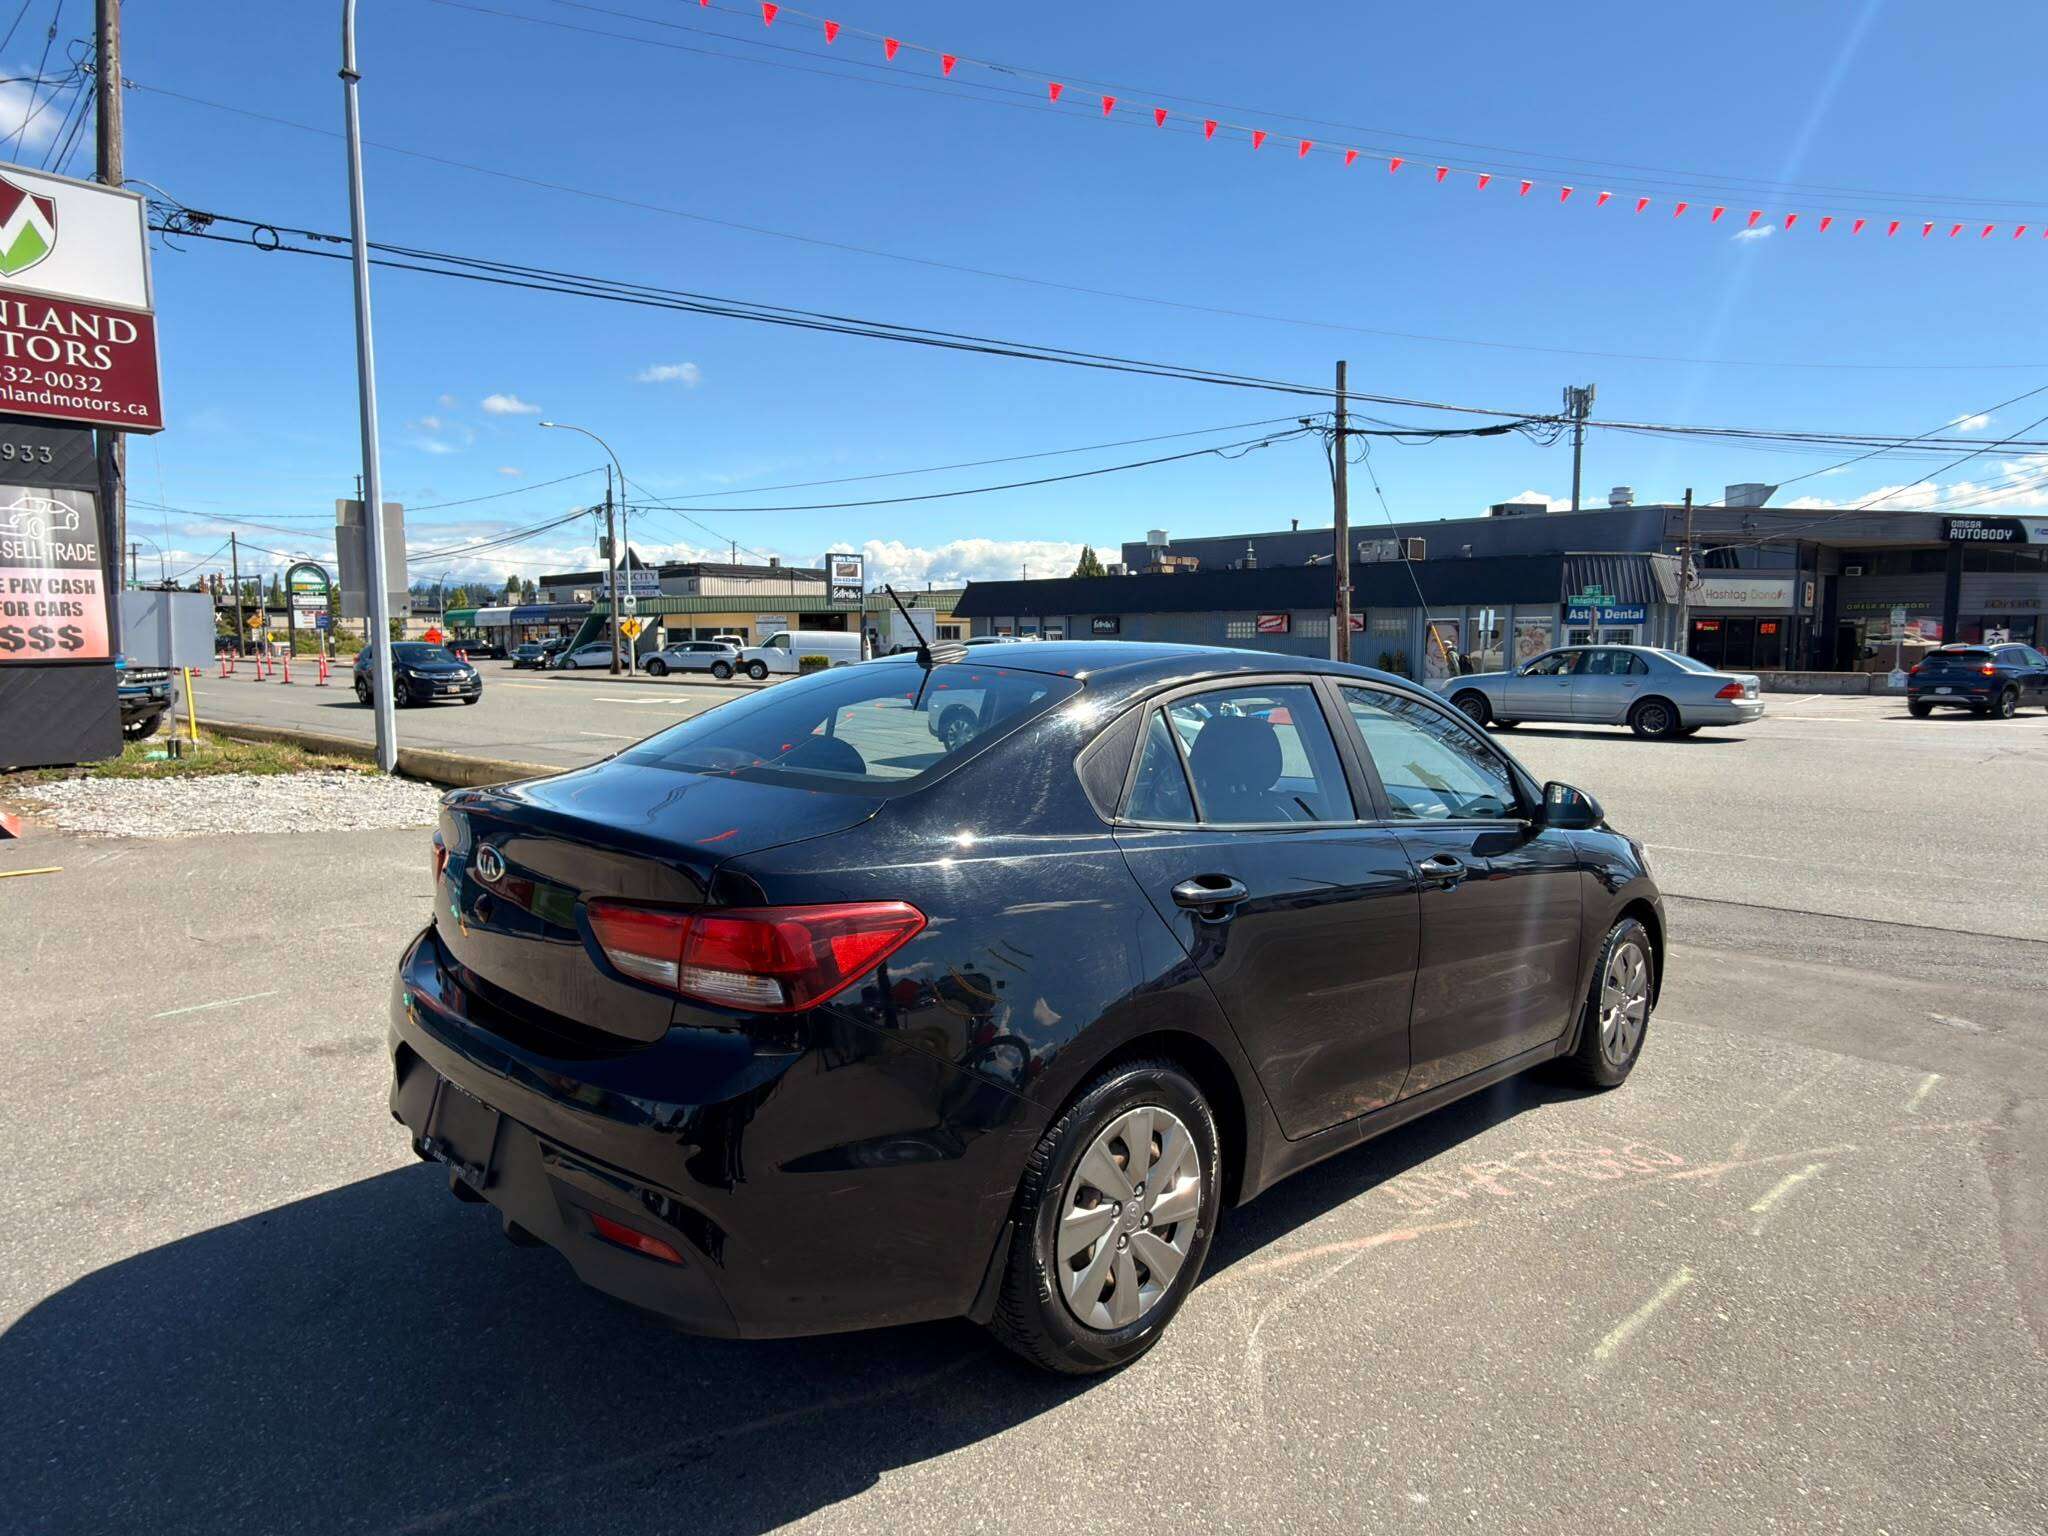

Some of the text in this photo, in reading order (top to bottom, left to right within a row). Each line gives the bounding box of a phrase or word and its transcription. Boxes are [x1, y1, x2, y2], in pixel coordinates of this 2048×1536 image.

[0, 365, 103, 392] 32-0032
[1951, 520, 1981, 528] OMEGA
[1949, 528, 2013, 540] AUTOBODY
[9, 578, 42, 594] PAY
[47, 578, 97, 594] CASH
[1706, 588, 1747, 602] Hashtag
[0, 600, 84, 617] OR CARS
[1569, 608, 1645, 620] Asta Dental
